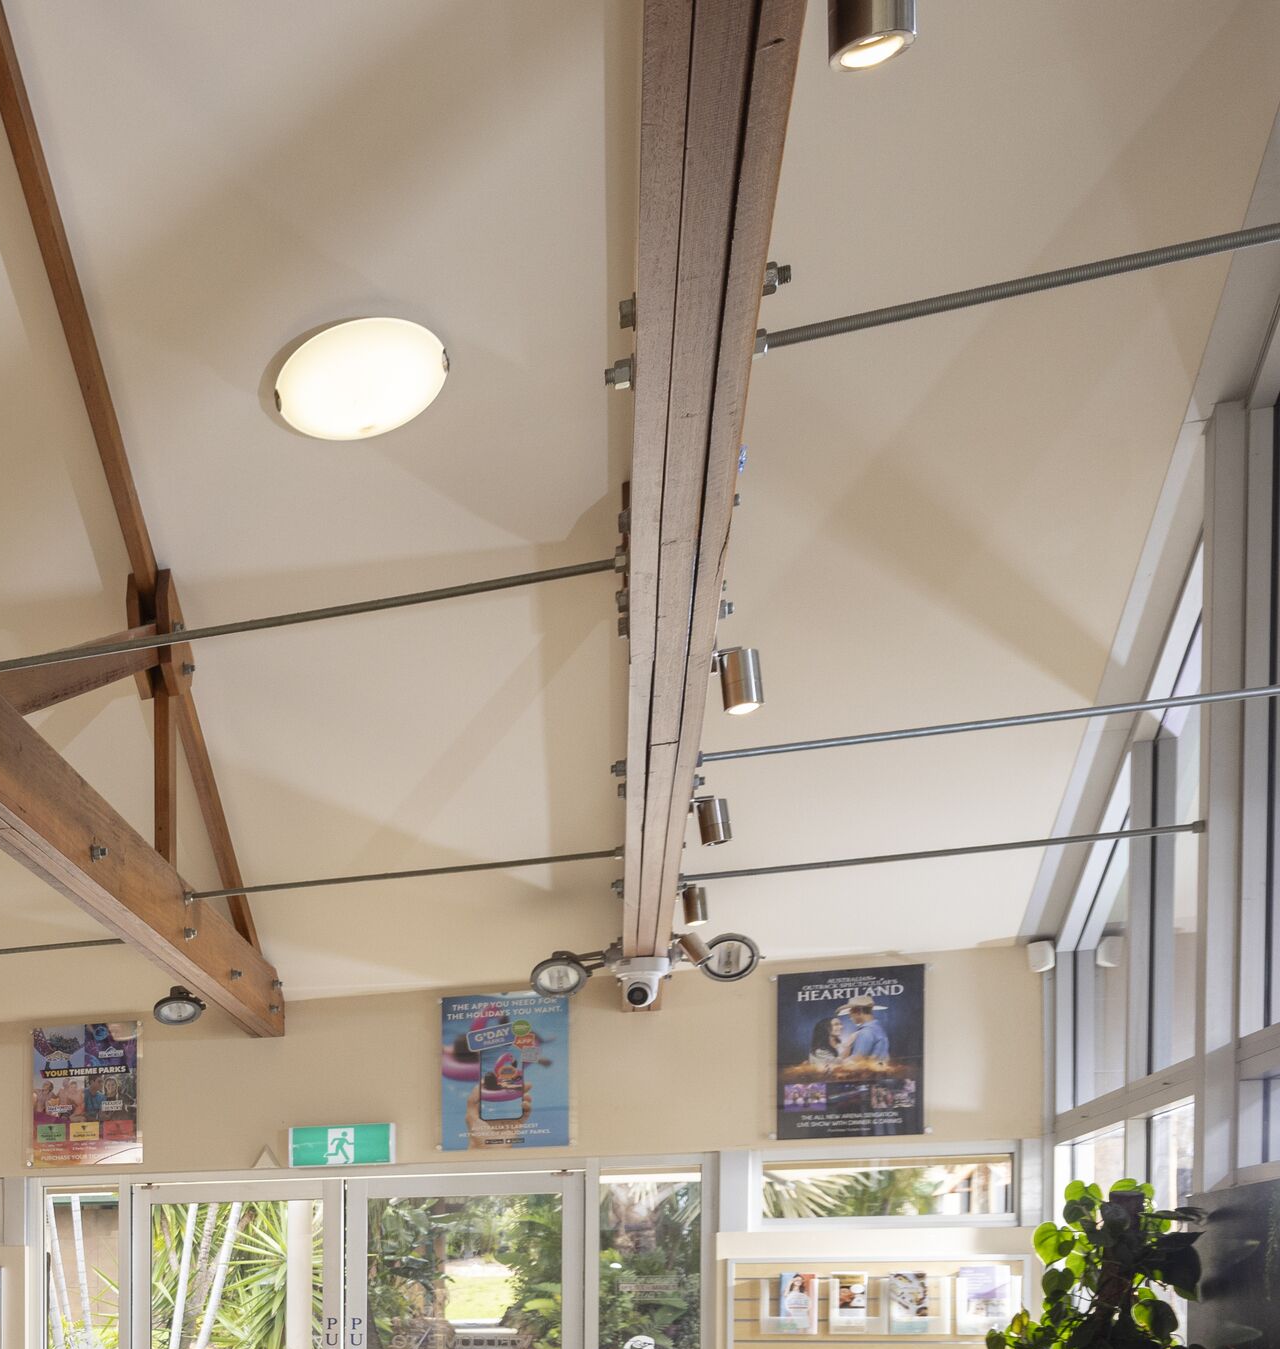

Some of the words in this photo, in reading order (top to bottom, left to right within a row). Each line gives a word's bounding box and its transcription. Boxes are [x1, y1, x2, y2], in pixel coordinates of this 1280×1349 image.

[797, 985, 904, 1002] HEARTLAND
[471, 1002, 489, 1010] APP
[490, 1000, 509, 1008] YOU
[538, 996, 558, 1004] FOR
[466, 1010, 511, 1019] HOLIDAYS
[474, 1027, 510, 1042] G'DAY
[45, 1069, 68, 1077] YOUR
[69, 1067, 98, 1075] THEME
[98, 1065, 126, 1073] PARKS
